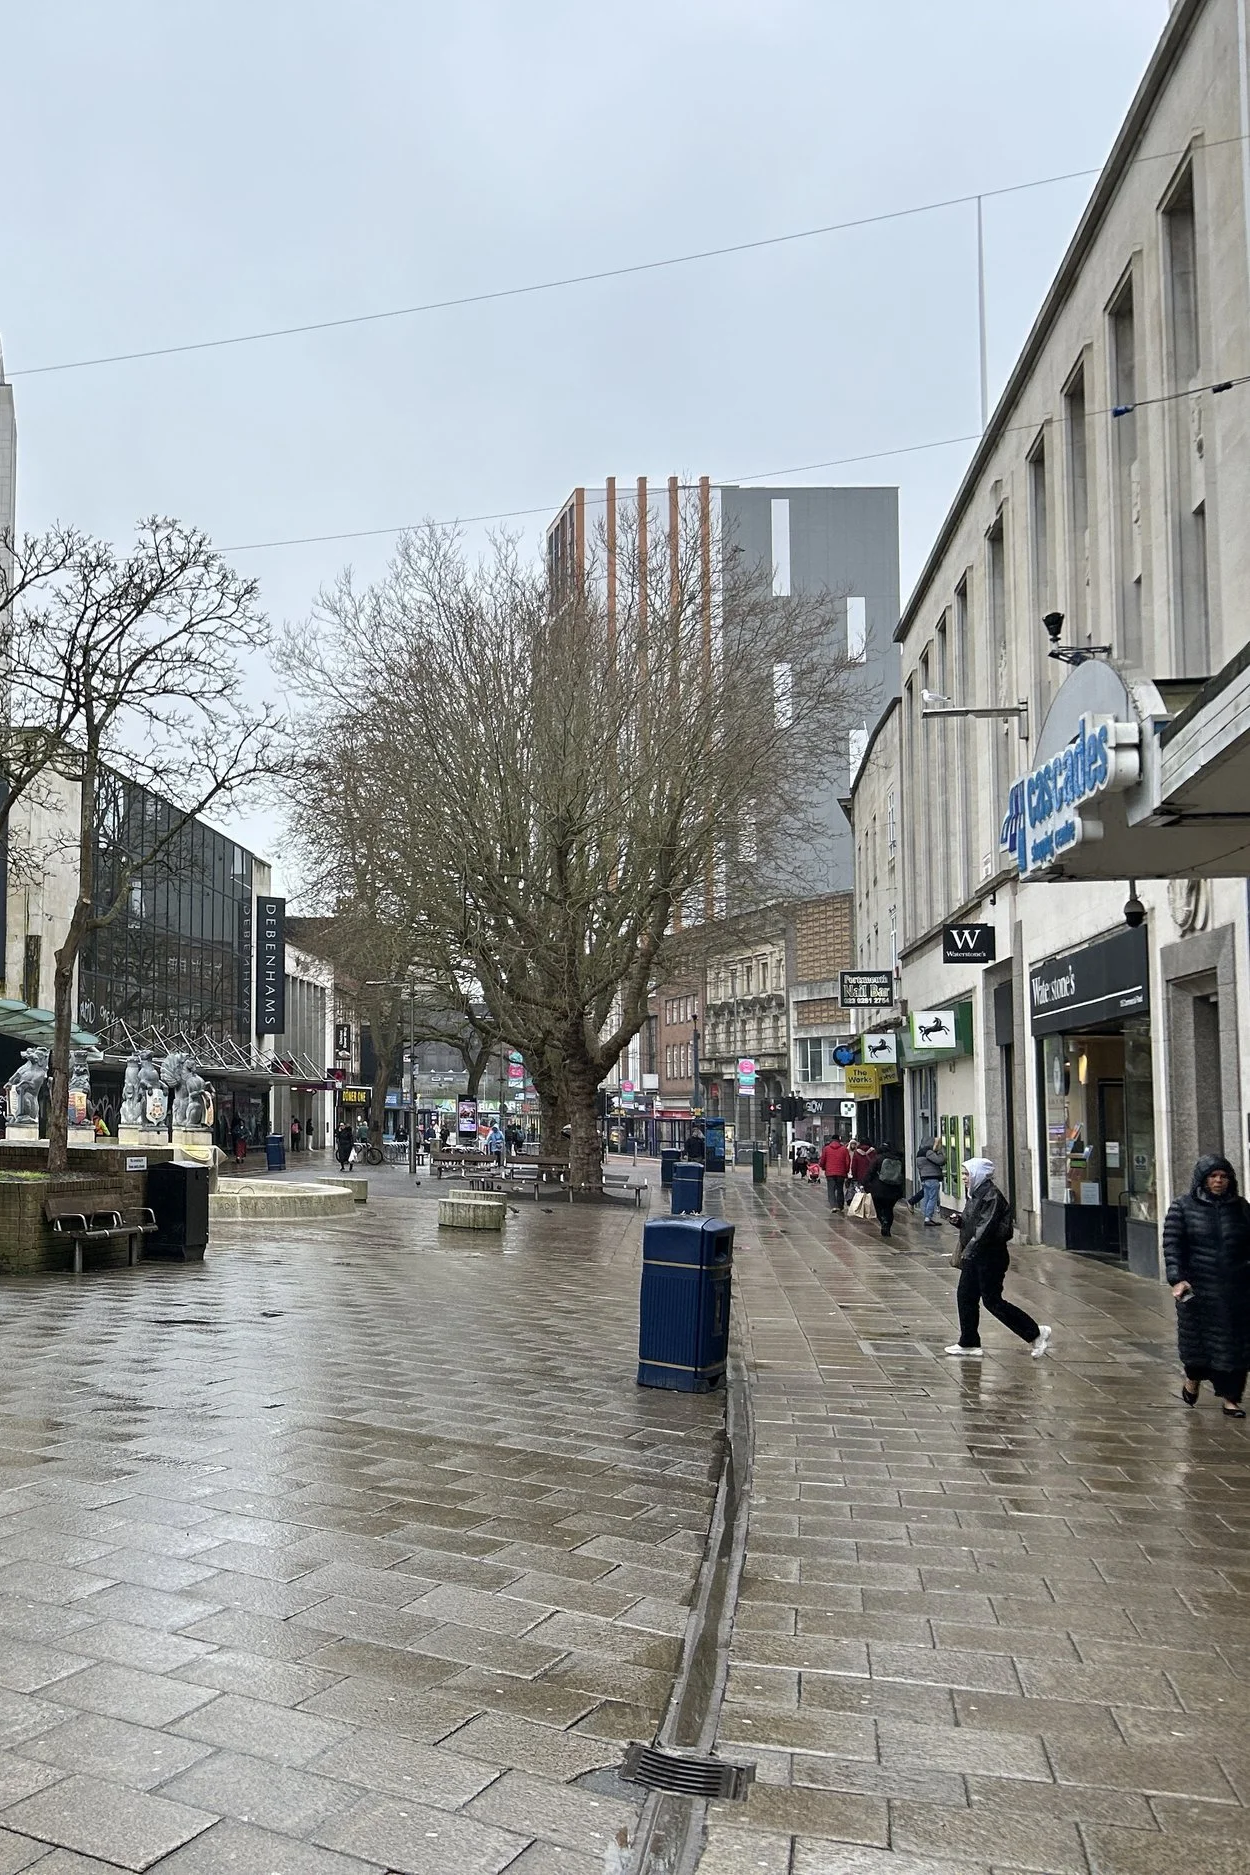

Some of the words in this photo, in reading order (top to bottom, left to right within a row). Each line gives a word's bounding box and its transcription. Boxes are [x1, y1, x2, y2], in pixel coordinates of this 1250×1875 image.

[1027, 718, 1108, 829] cascades
[265, 904, 276, 1024] DEBENHAMS
[950, 929, 981, 949] W
[843, 984, 867, 997] Nail
[870, 984, 890, 997] Bar
